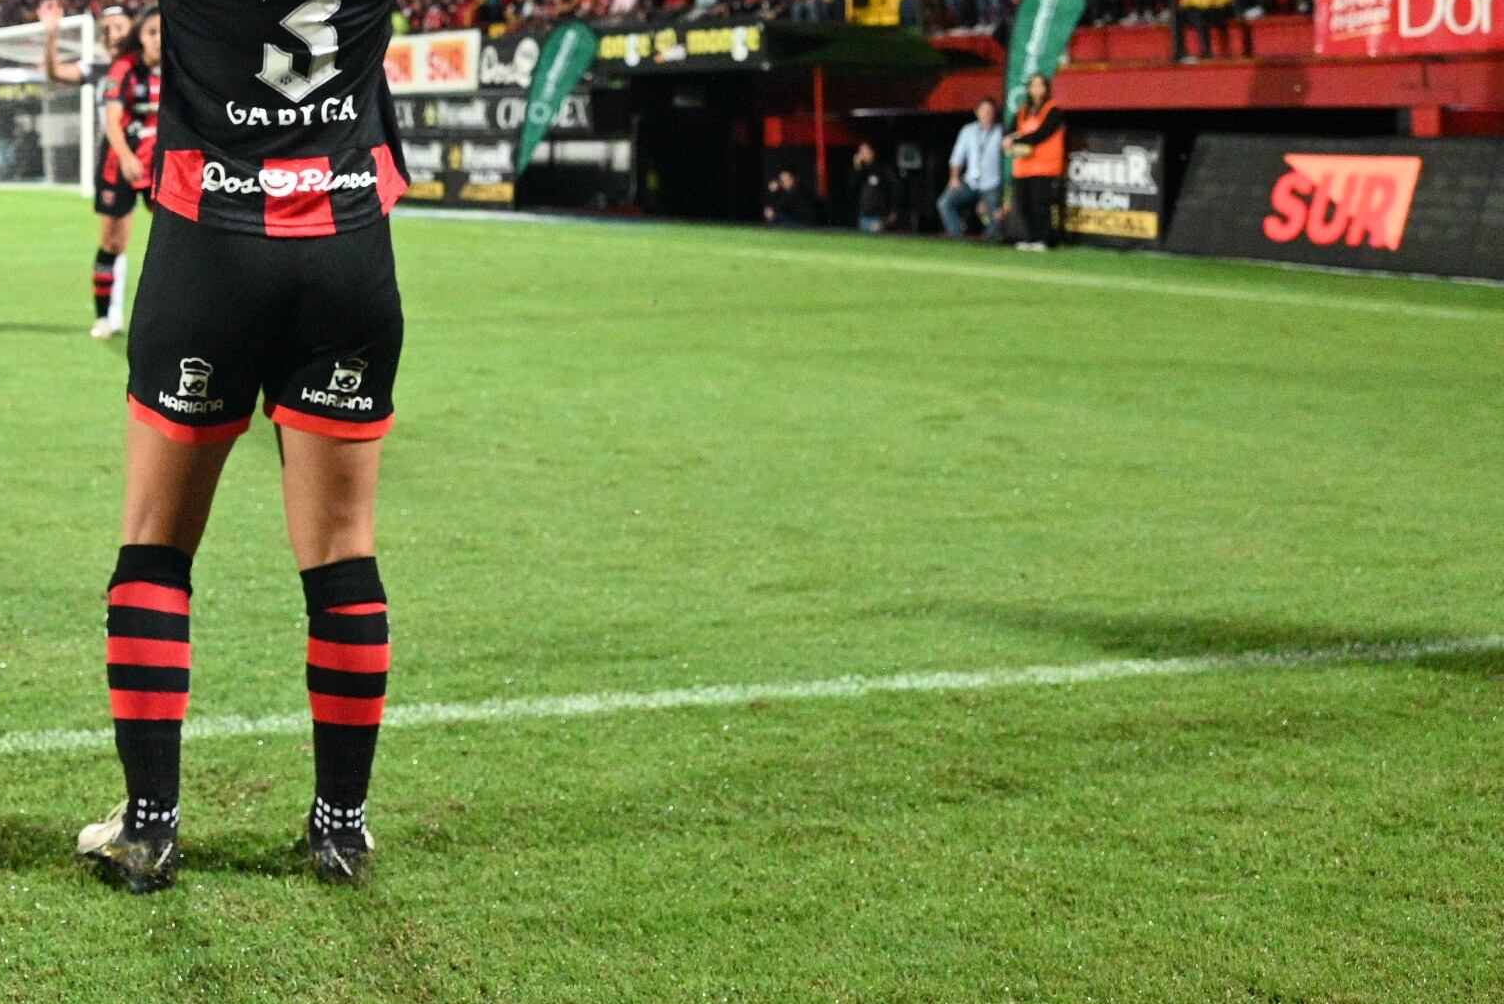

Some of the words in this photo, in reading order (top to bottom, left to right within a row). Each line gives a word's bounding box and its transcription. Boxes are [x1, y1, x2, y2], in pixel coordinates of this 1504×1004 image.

[201, 161, 262, 194] Dos
[296, 168, 378, 192] Pinos
[1262, 169, 1399, 250] SUR
[158, 390, 225, 414] HARIANA
